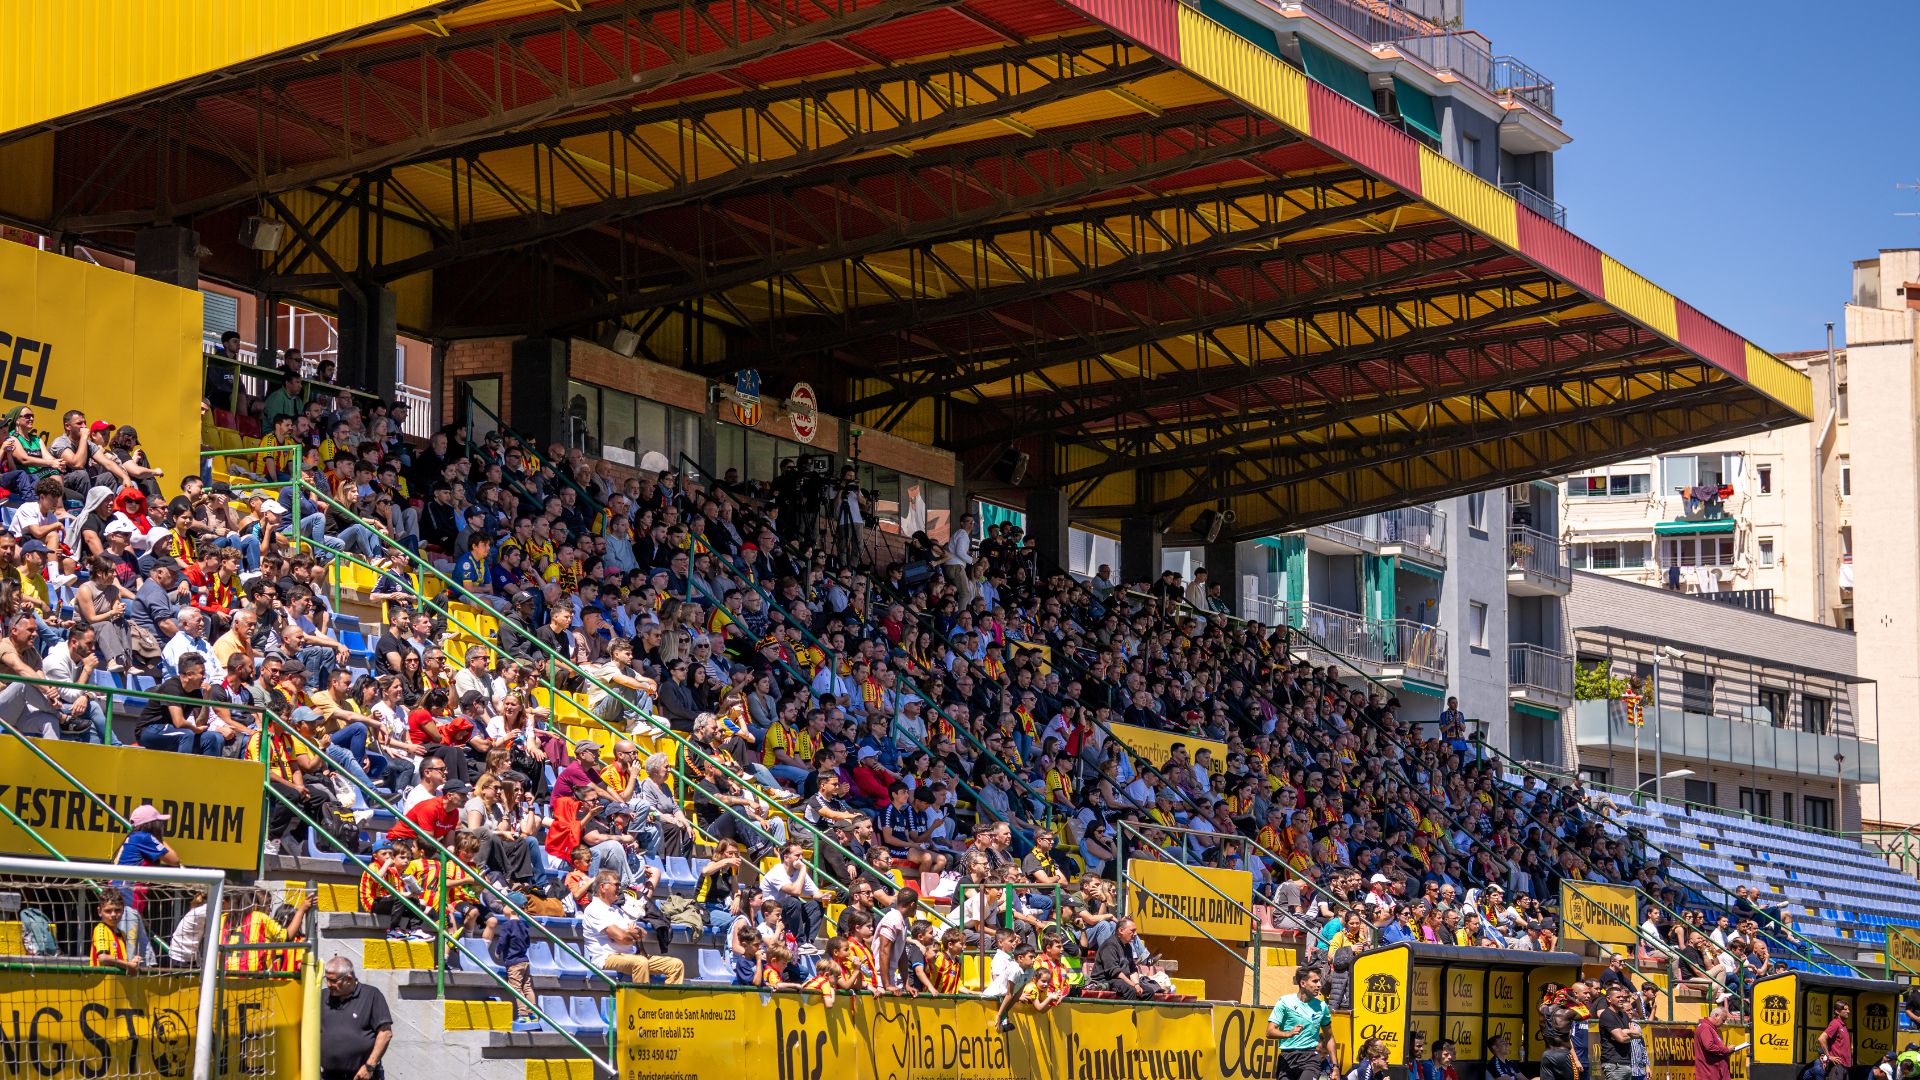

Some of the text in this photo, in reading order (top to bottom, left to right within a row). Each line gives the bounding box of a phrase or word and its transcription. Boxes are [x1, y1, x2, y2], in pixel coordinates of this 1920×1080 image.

[13, 786, 245, 844] ESTRELL DAMM
[1151, 892, 1244, 926] ESTRELLA DAMM
[1585, 900, 1631, 927] OPEN ARMS
[637, 1008, 736, 1021] Carrer Gran de Sant Andreu 223
[638, 1026, 695, 1039] Carrer Treball 255
[637, 1049, 678, 1061] 933 450 427
[941, 1023, 1011, 1070] Dental
[1654, 1037, 1669, 1061] 933
[1669, 1037, 1686, 1061] 466
